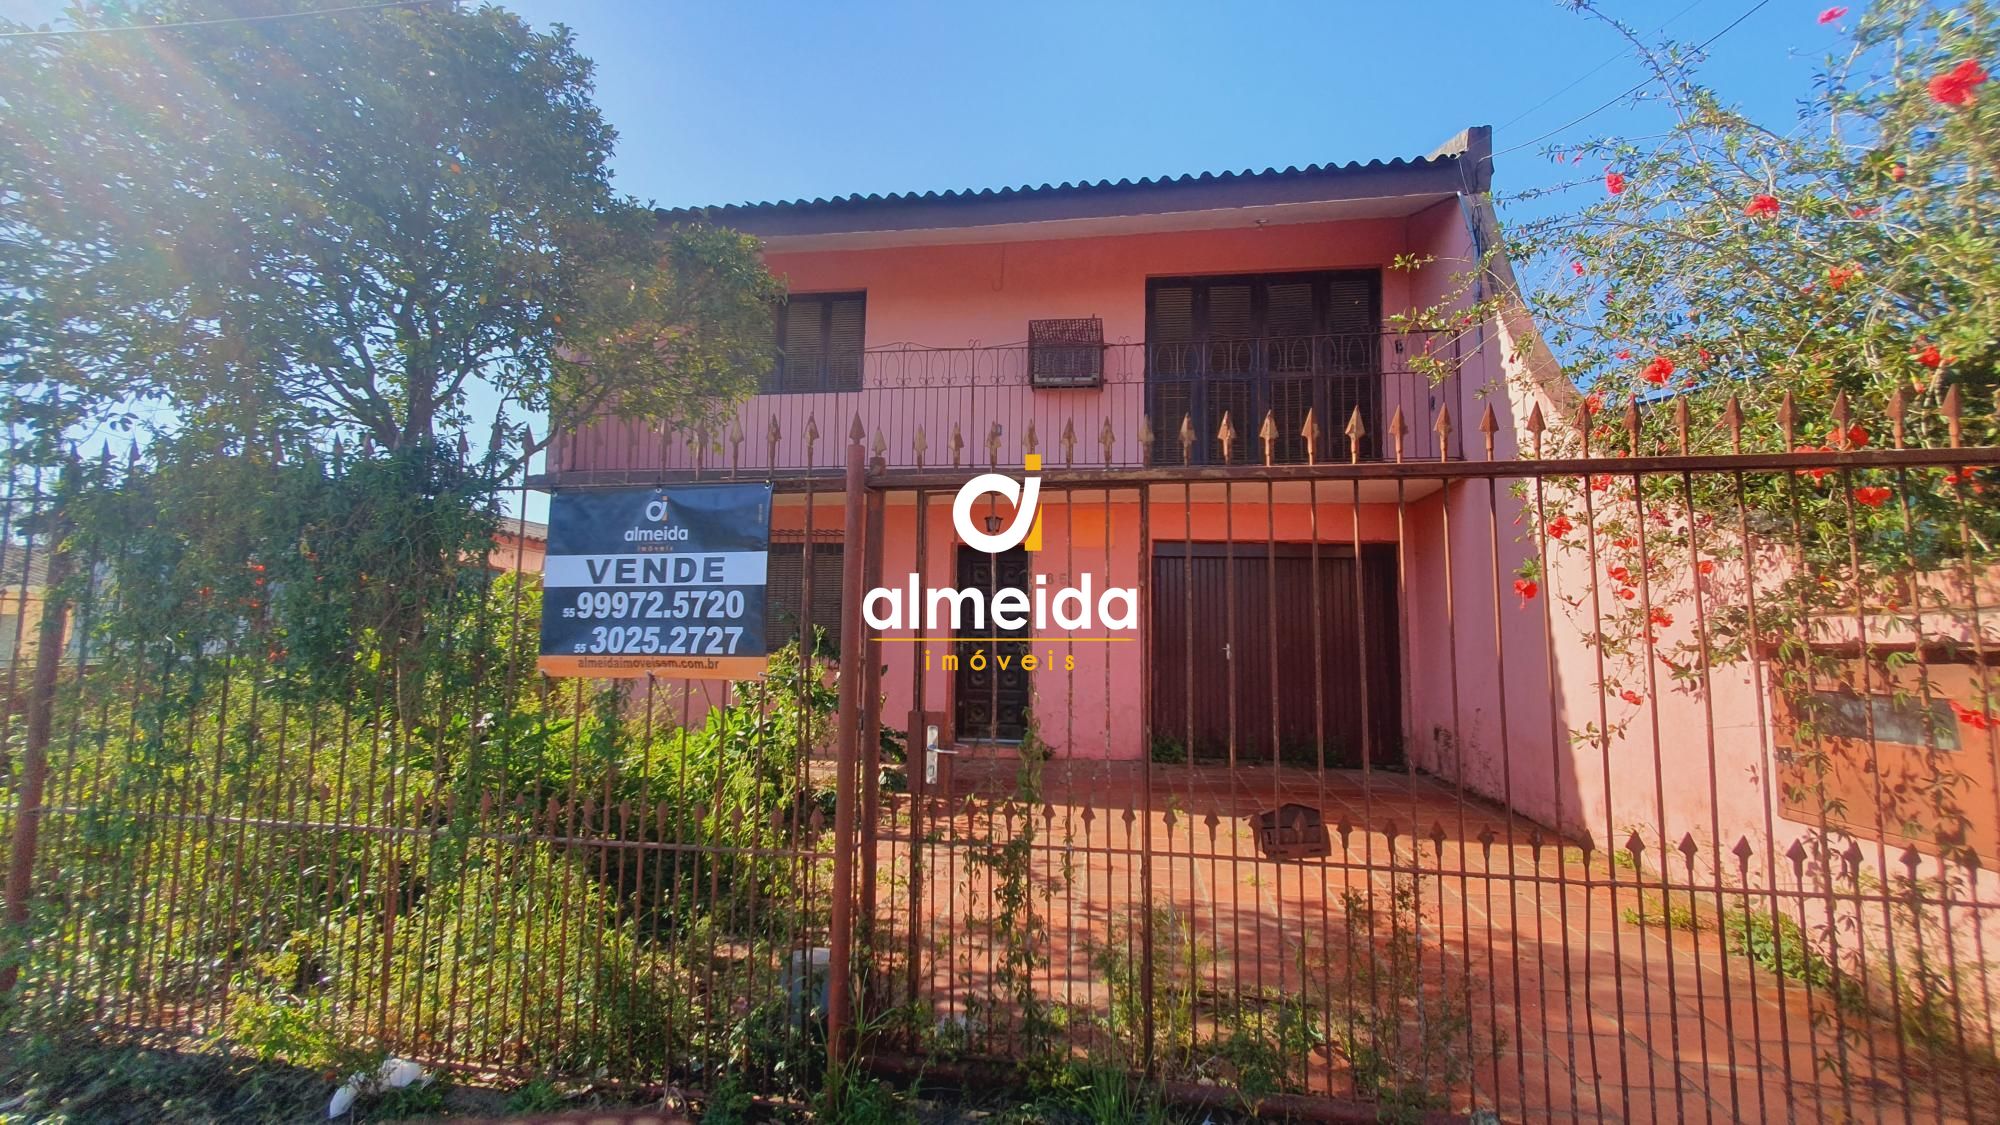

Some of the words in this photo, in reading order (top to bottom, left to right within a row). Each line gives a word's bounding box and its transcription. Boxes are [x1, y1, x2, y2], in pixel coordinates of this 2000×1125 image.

[624, 525, 688, 541] almeida
[586, 556, 726, 584] VENDE
[562, 607, 576, 618] 55
[577, 590, 744, 619] 99972.5720
[573, 643, 587, 654] 55
[589, 626, 743, 655] 3025.2727
